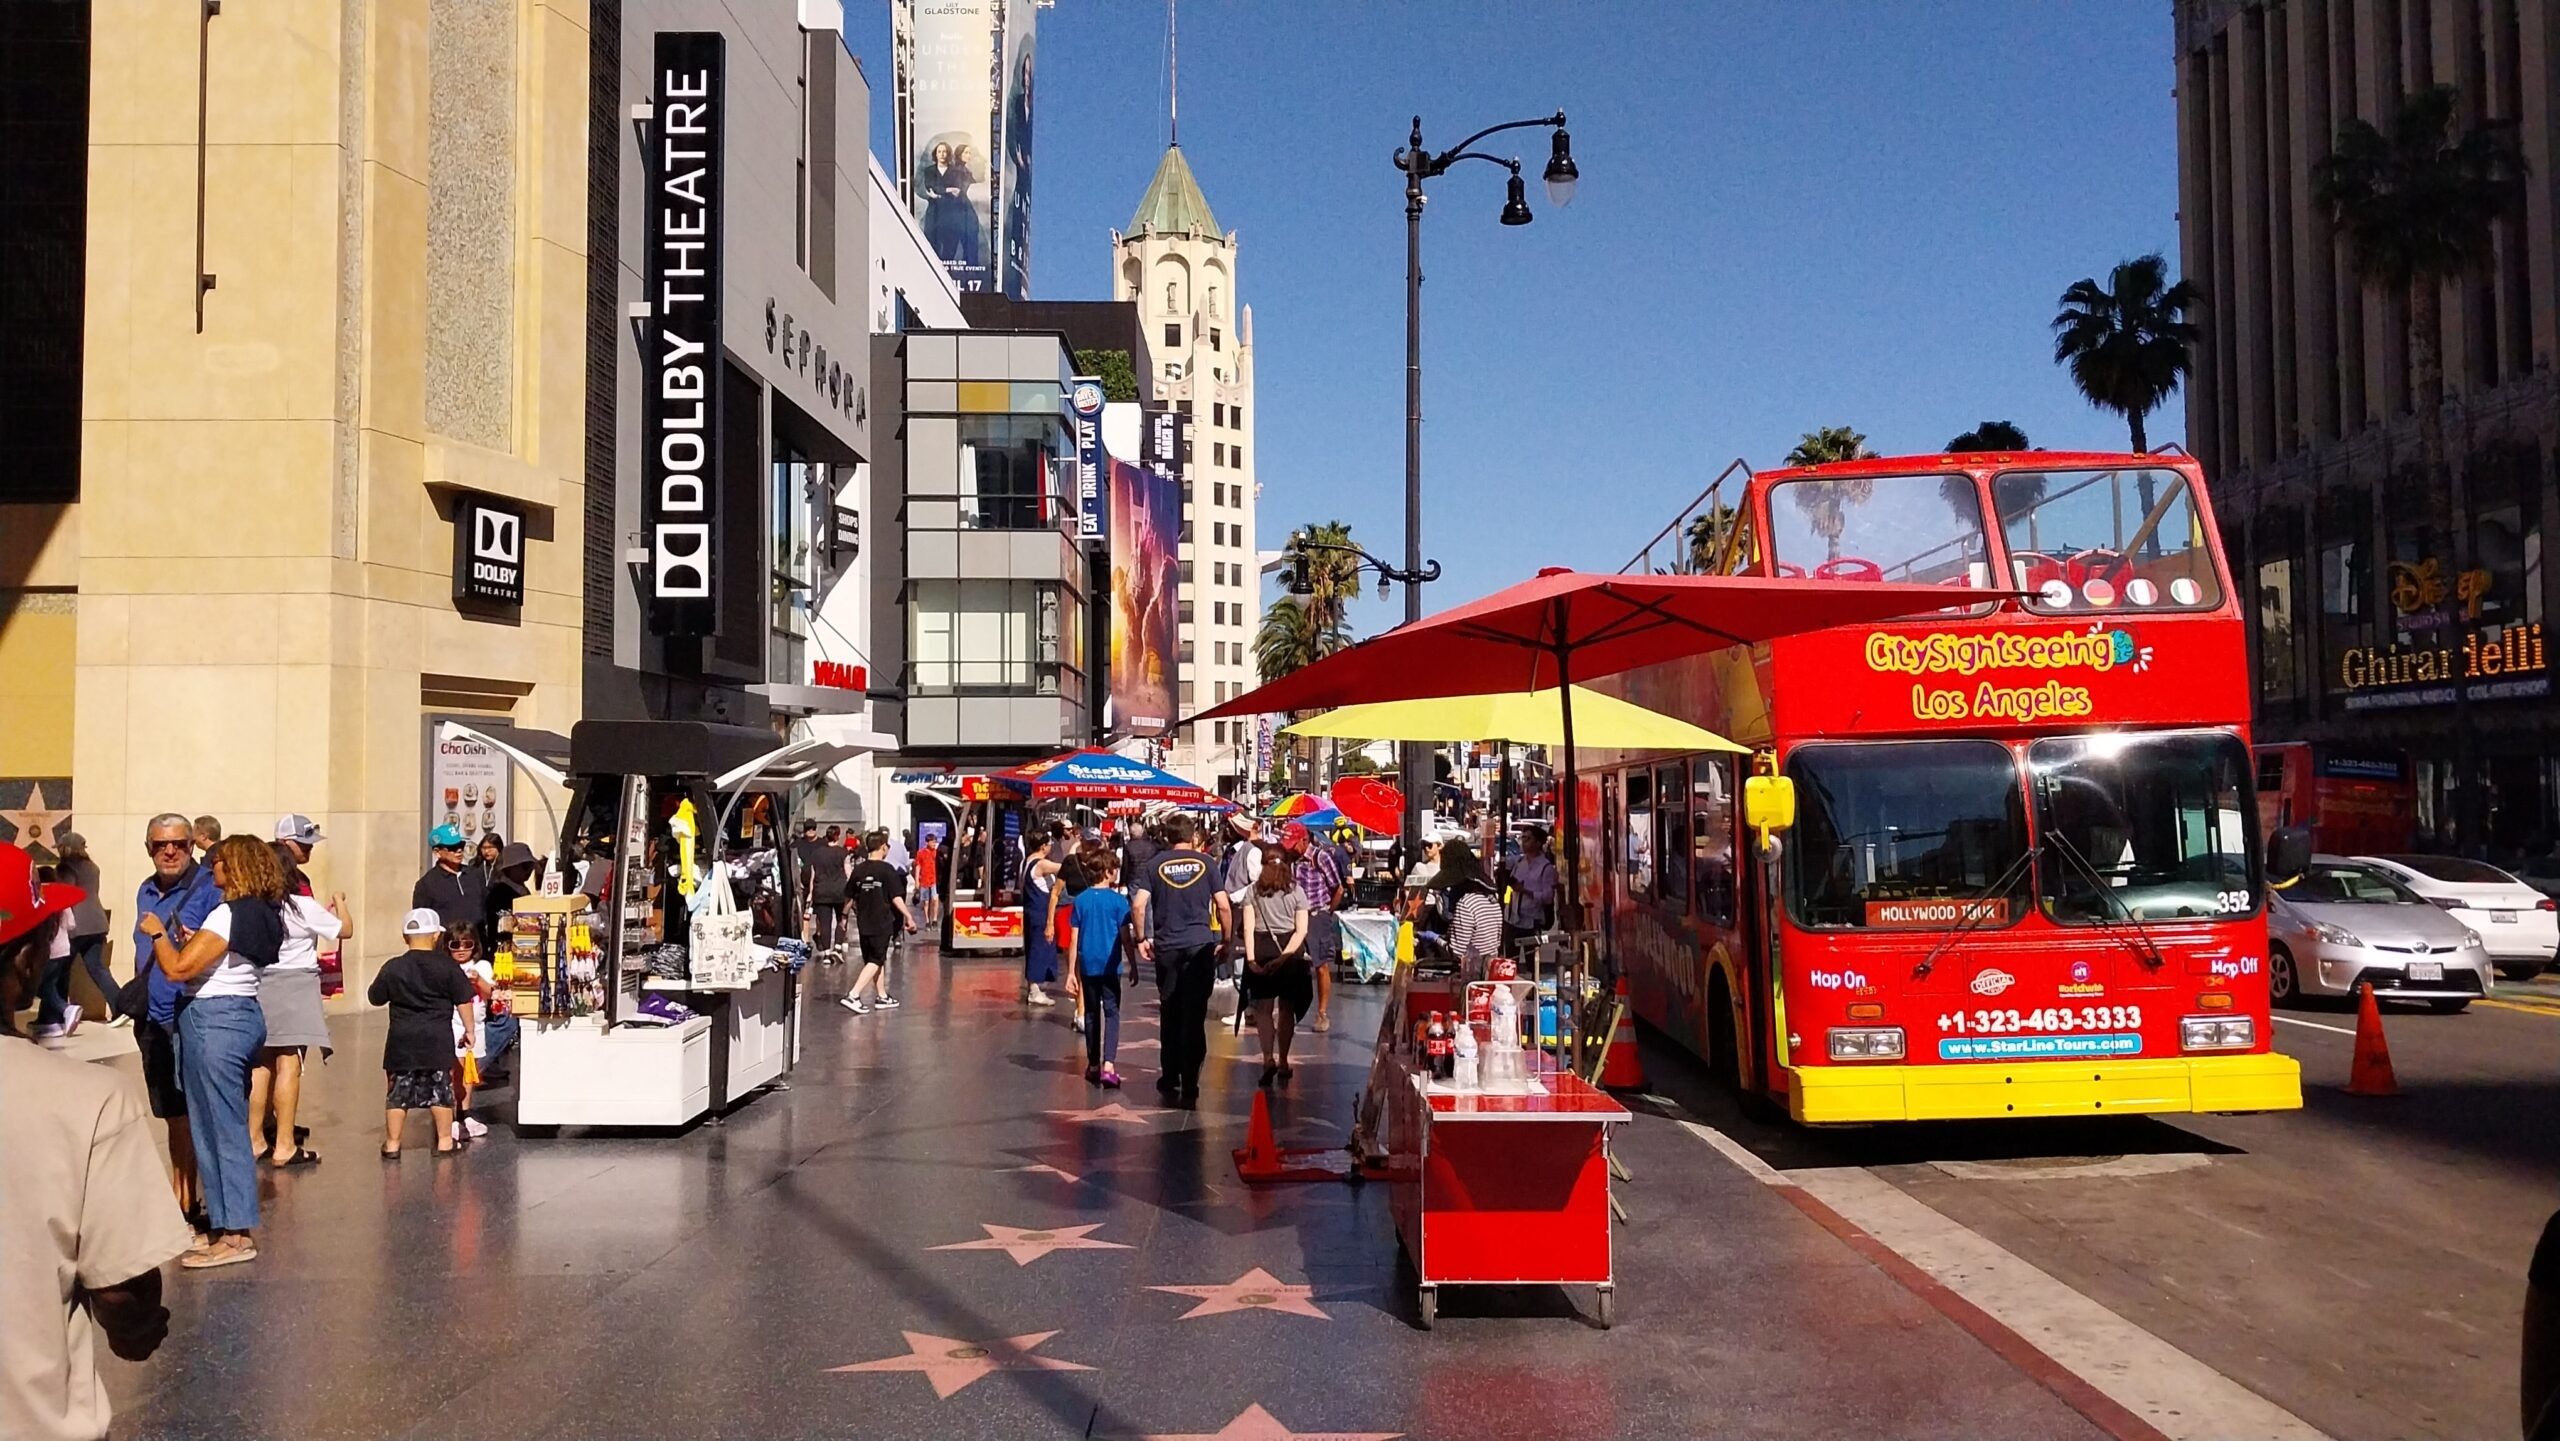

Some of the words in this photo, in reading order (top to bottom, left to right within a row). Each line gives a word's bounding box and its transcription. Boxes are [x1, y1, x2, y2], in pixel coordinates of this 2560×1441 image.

[924, 7, 980, 15] GLADSTONE
[664, 68, 708, 315] THEATRE
[967, 280, 983, 292] 17
[764, 296, 867, 425] SEPHORA
[661, 329, 705, 512] DOLBY
[1081, 420, 1096, 449] PLAY
[1082, 462, 1097, 499] DRINK
[838, 512, 858, 529] SHOPS
[1083, 511, 1098, 533] EAT
[837, 529, 859, 545] DINING
[473, 562, 518, 585] DOLBY
[473, 584, 518, 599] THEATRE
[1866, 630, 2115, 676] CitySightseeing
[1912, 684, 1969, 720] Los
[1973, 680, 2093, 722] Angeles
[440, 743, 463, 756] Cho
[463, 743, 487, 756] Oishi
[1299, 762, 1308, 771] M
[1039, 785, 1069, 793] TICKETS
[1132, 787, 1160, 795] KARTEN
[1163, 863, 1201, 875] KIMO'S
[546, 881, 559, 894] 99
[2216, 889, 2251, 914] 352
[1880, 905, 1956, 921] HOLLYWOOD
[1961, 903, 1996, 920] TOUR
[2211, 959, 2239, 980] Hop
[2240, 956, 2260, 974] Off
[1810, 969, 1842, 989] Hop
[1843, 970, 1867, 988] On
[1937, 1005, 2142, 1033] +1-323-463-3333
[1948, 1037, 2134, 1055] www.StarLineTours.com
